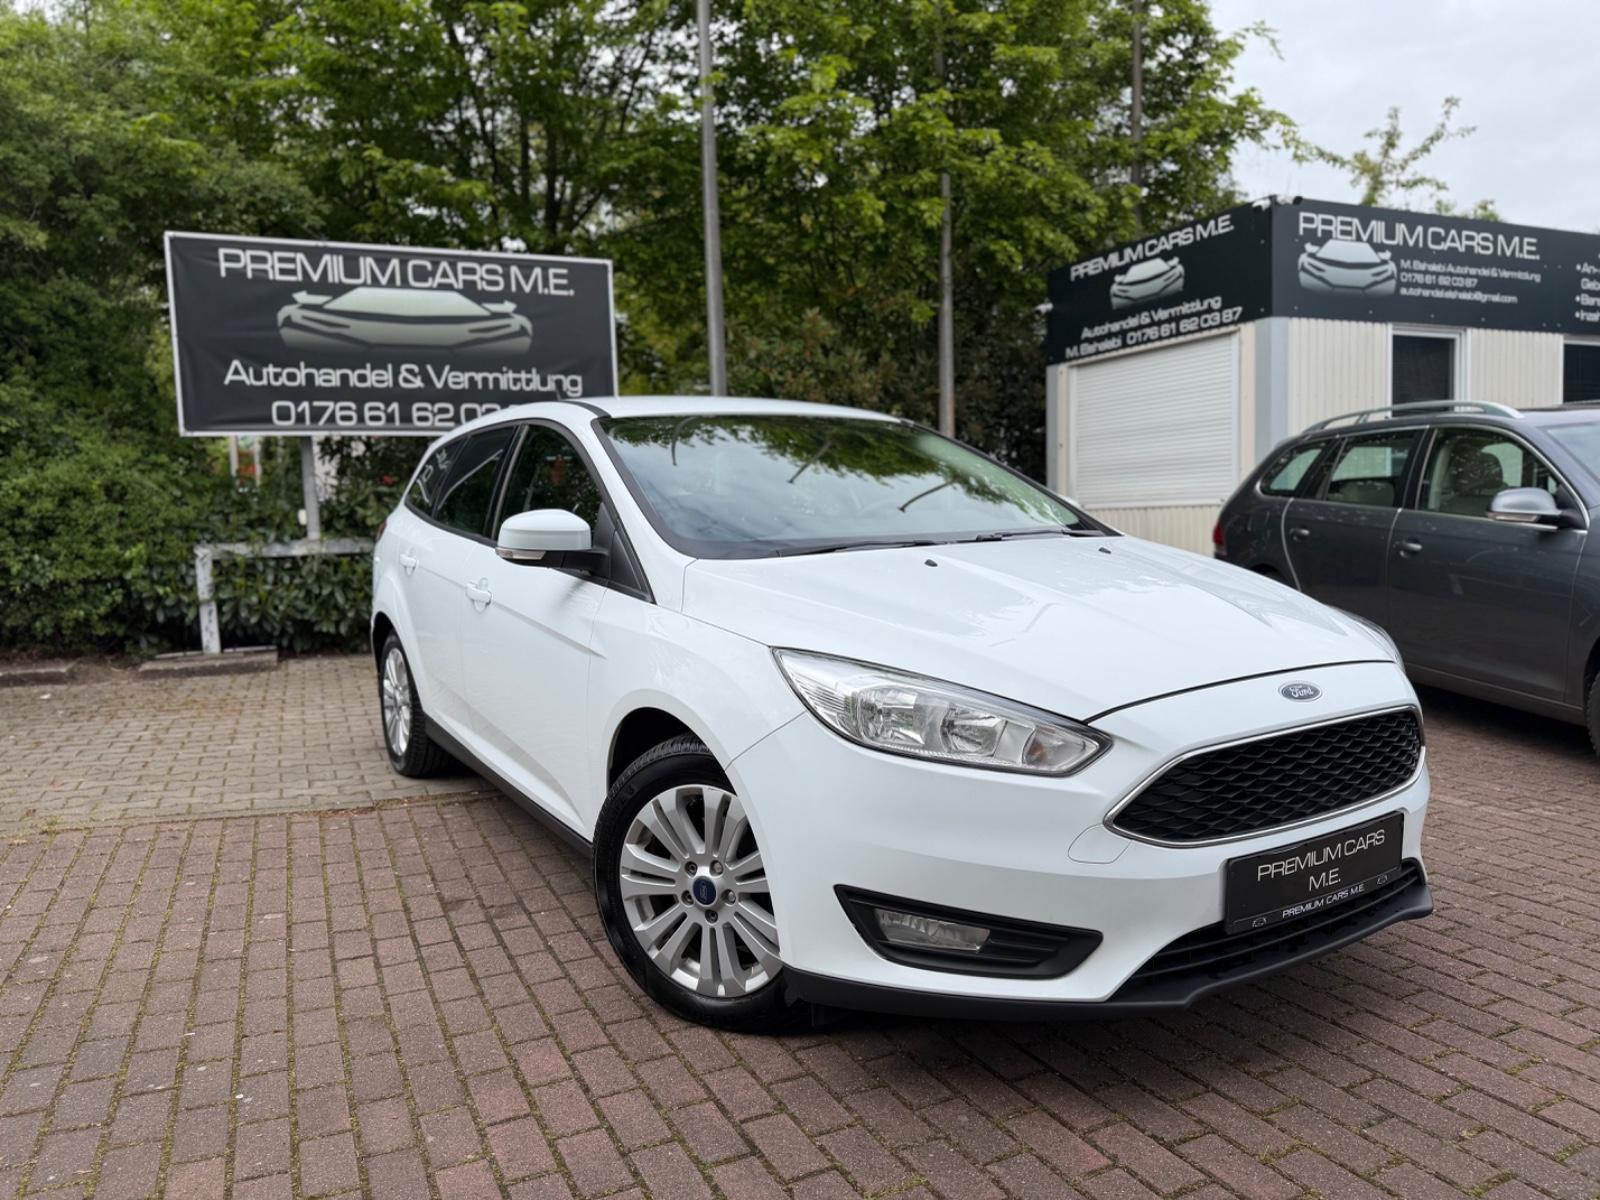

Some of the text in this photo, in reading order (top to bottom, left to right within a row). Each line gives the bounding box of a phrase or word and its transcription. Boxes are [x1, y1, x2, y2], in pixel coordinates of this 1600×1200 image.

[1070, 214, 1235, 282] PREMIUM CARS M.E.
[1299, 211, 1541, 260] PREMIUM CARS M.E.
[218, 248, 575, 296] PREMIUM CARS M.E.
[1081, 296, 1222, 339] Autohandel & Vermittlung
[1126, 326, 1159, 345] 0176
[1160, 322, 1176, 337] 61
[1179, 317, 1199, 333] 62
[1200, 312, 1220, 328] 03
[1222, 306, 1242, 322] 87
[224, 359, 582, 397] Autohandel & Vermittlung
[272, 400, 358, 427] 0176
[363, 401, 400, 427] 61
[412, 402, 455, 427] 62
[1257, 829, 1385, 881] PREMIUM CARS
[1309, 868, 1342, 892] M.E.
[1282, 900, 1325, 919] PREMIUM
[1326, 890, 1349, 905] CARS
